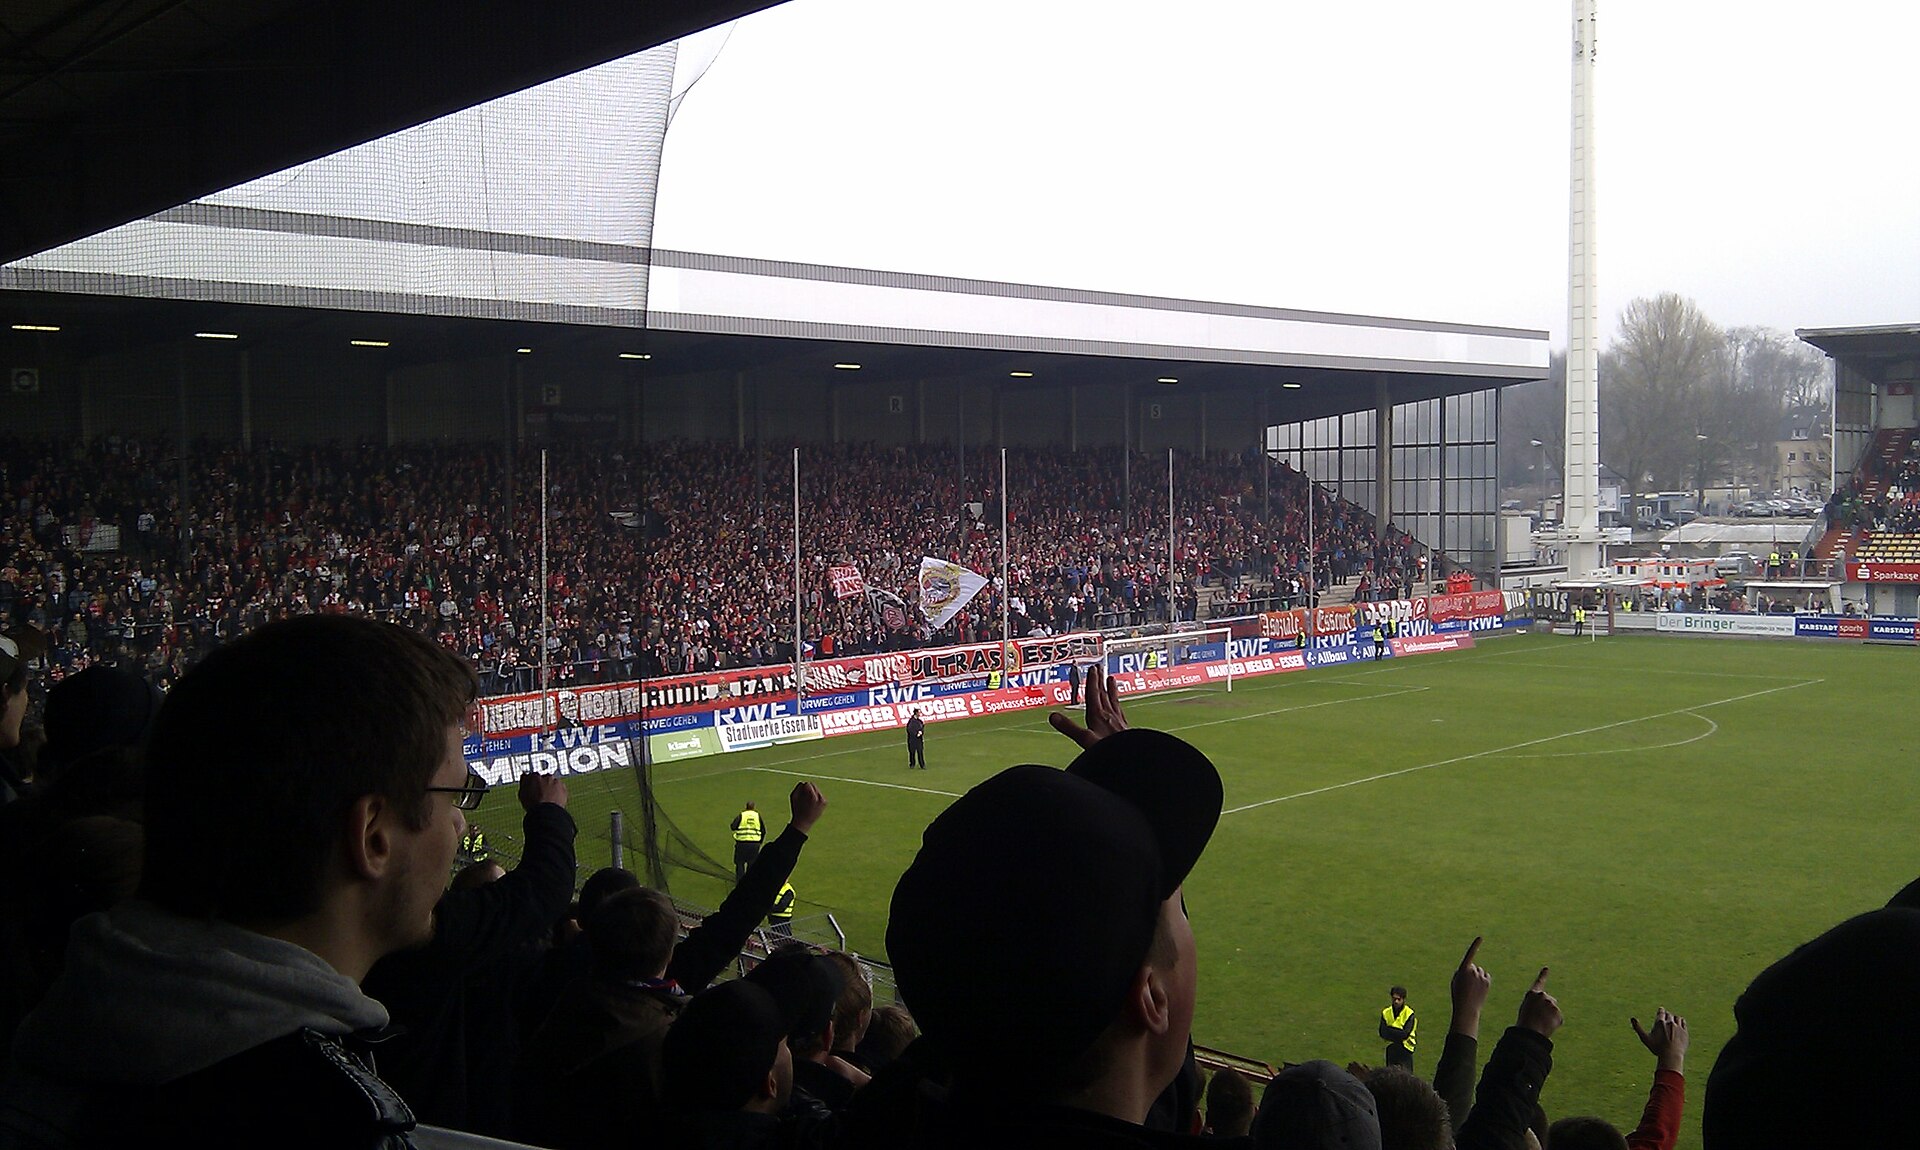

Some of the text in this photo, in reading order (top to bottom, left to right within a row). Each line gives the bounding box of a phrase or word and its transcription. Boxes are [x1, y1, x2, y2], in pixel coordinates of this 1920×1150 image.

[1874, 571, 1919, 580] Sparkasse
[1502, 591, 1525, 611] WILD
[1536, 591, 1568, 613] BOYS
[1399, 619, 1436, 638] RWE
[1469, 616, 1503, 631] RWE
[1660, 615, 1735, 631] Der Bringer
[1799, 623, 1839, 631] KARSTADT
[1840, 623, 1864, 632] sports
[1873, 626, 1915, 634] KARSTADT
[1316, 627, 1358, 648] RWE
[1225, 638, 1270, 660] RWE
[1318, 650, 1348, 664] Allbau
[1362, 645, 1391, 658] Allu
[911, 637, 1098, 678] ULTRAS ESSEN
[1279, 655, 1305, 668] ESSEN
[1147, 678, 1182, 690] Sparkasse
[1181, 674, 1201, 684] Essen
[801, 694, 855, 710] ORWEG GEHEN
[869, 682, 935, 706] RWE
[985, 697, 1024, 712] Sparkasse
[1024, 695, 1047, 707] Essen
[673, 714, 698, 727] GEHEN
[713, 702, 791, 727] RWE
[727, 722, 780, 742] Stadtwerke
[781, 716, 807, 733] Essen
[808, 713, 819, 730] AG
[531, 724, 621, 752] RWE
[470, 741, 630, 787] MEDION
